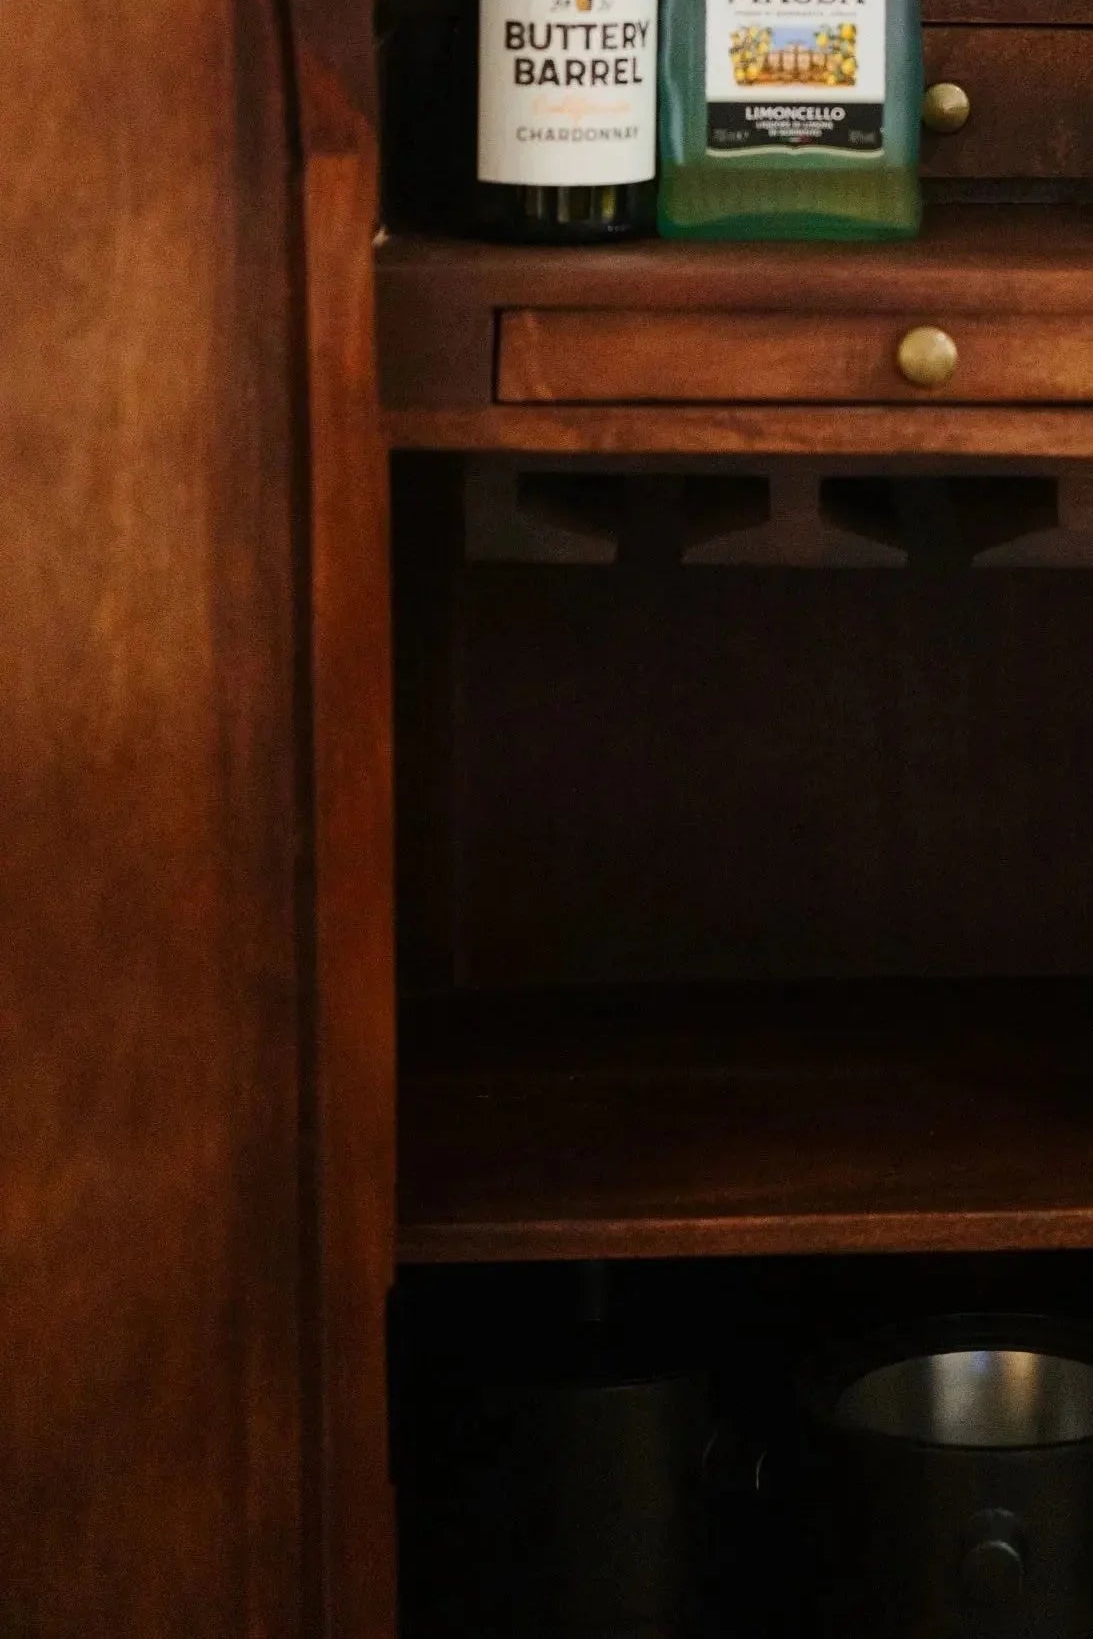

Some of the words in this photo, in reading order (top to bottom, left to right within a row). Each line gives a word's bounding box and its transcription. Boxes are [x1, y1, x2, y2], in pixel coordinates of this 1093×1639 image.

[504, 20, 650, 50] BUTTERY
[513, 57, 643, 86] BARREL
[744, 106, 846, 122] LIMONCELLO
[515, 124, 640, 143] CHARDONNAY
